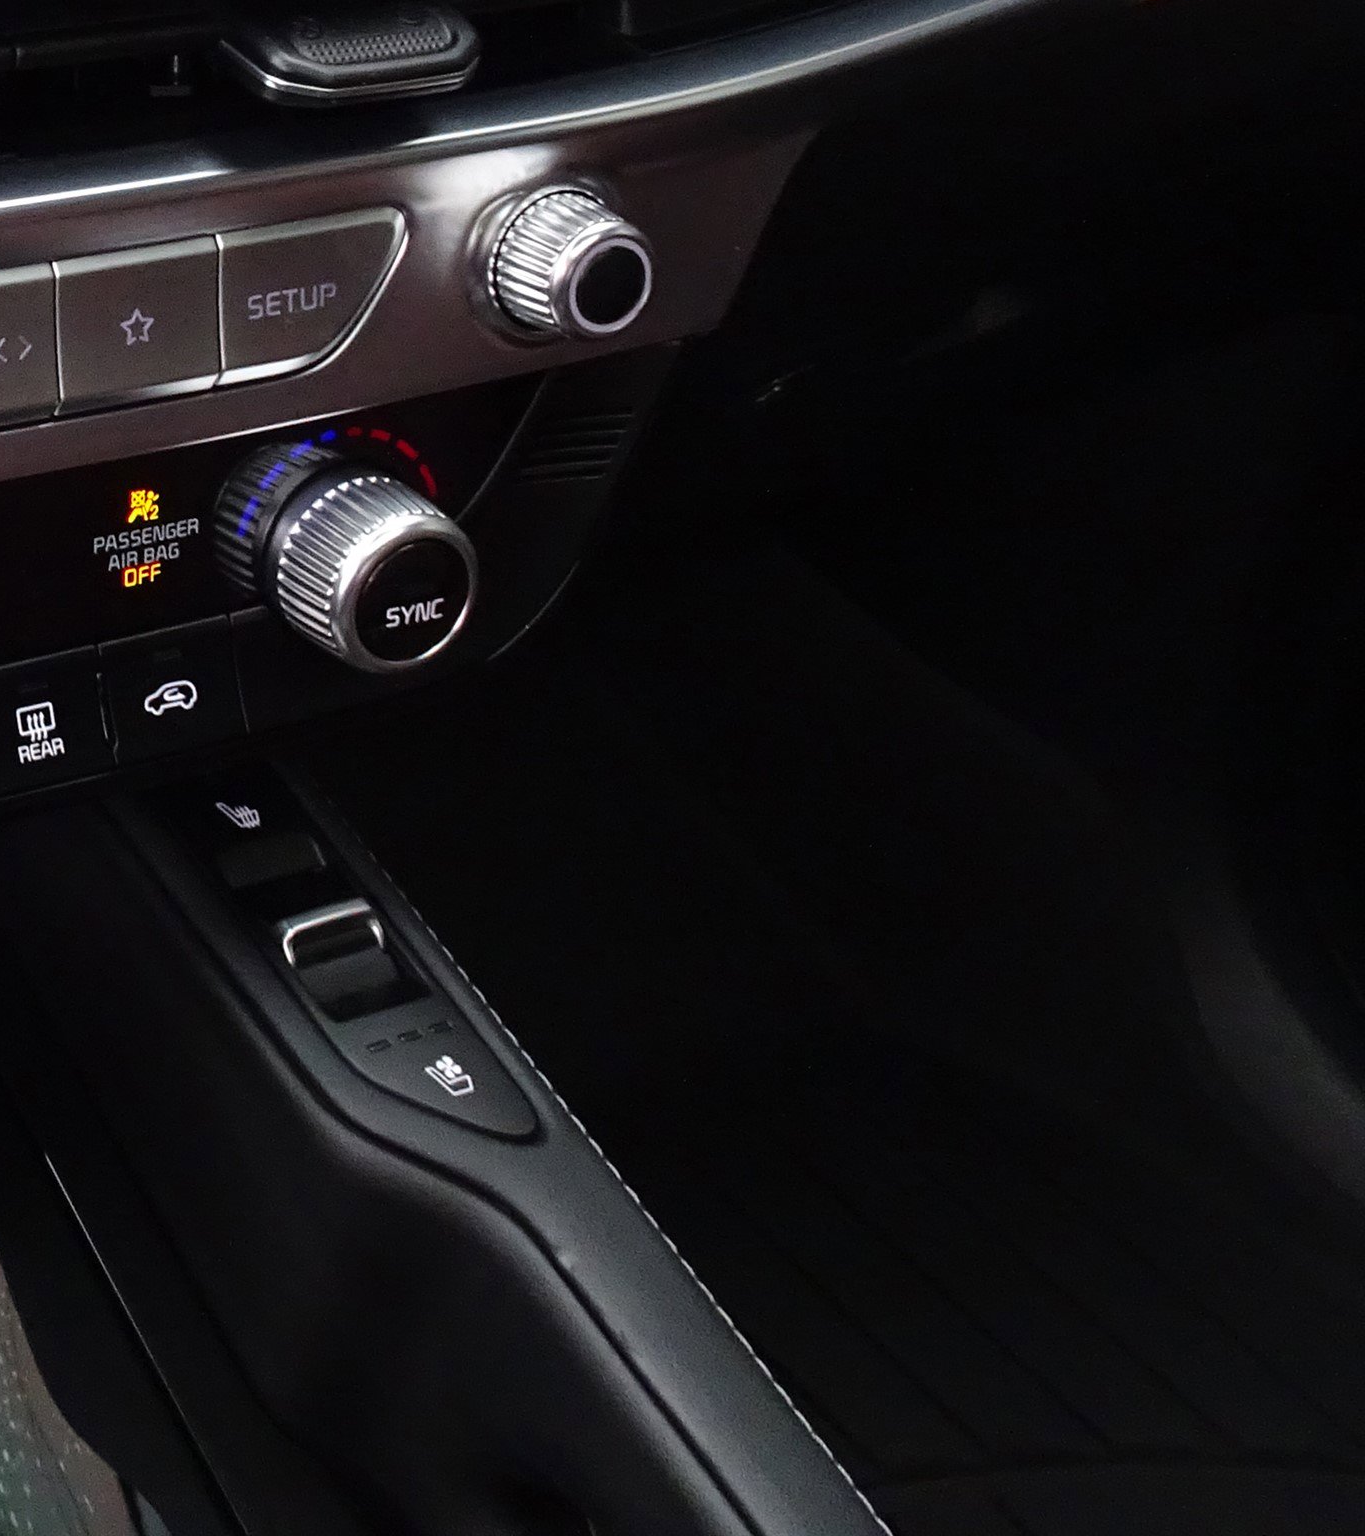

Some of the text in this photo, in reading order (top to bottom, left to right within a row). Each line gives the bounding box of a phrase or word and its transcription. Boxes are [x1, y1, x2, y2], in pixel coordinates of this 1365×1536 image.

[247, 282, 338, 321] SETUP
[93, 518, 200, 554] PASSENGER
[108, 542, 180, 571] AIR BAG
[124, 563, 161, 588] OFF
[384, 598, 444, 628] SYNC
[17, 739, 66, 763] REAR
